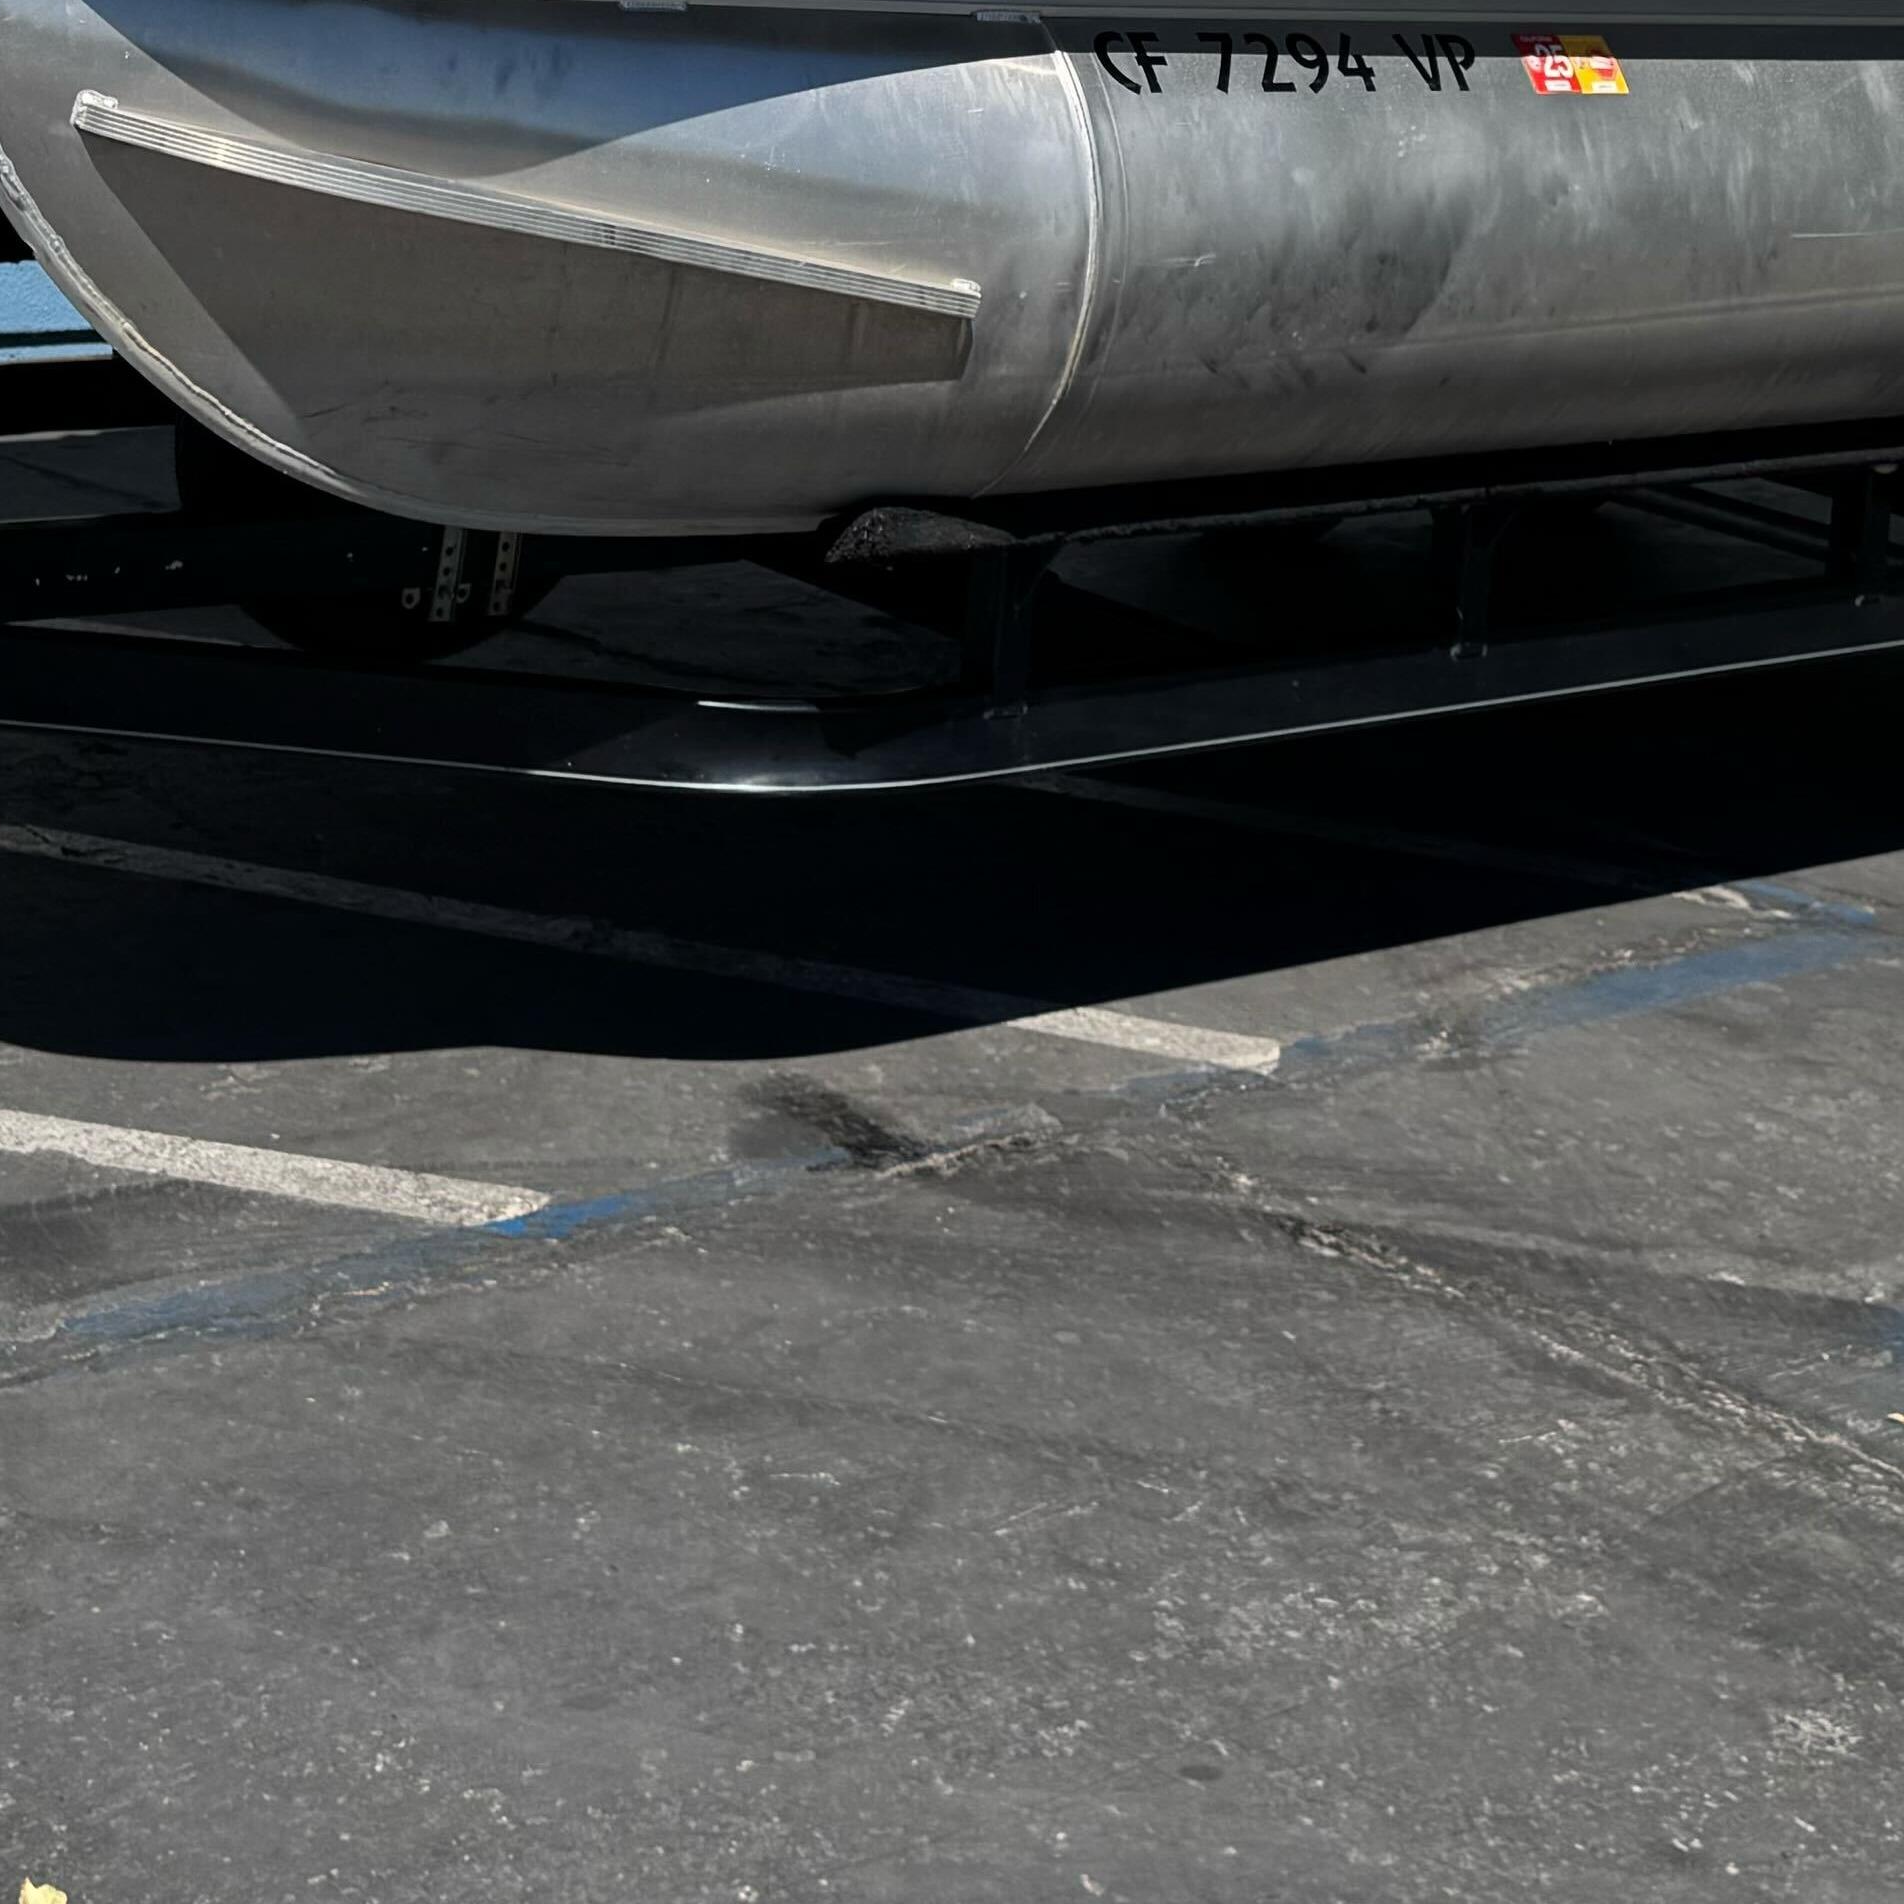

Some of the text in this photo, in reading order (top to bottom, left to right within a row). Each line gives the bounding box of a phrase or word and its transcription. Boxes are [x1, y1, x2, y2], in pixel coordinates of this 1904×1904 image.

[1094, 30, 1476, 96] CF 7294 VP
